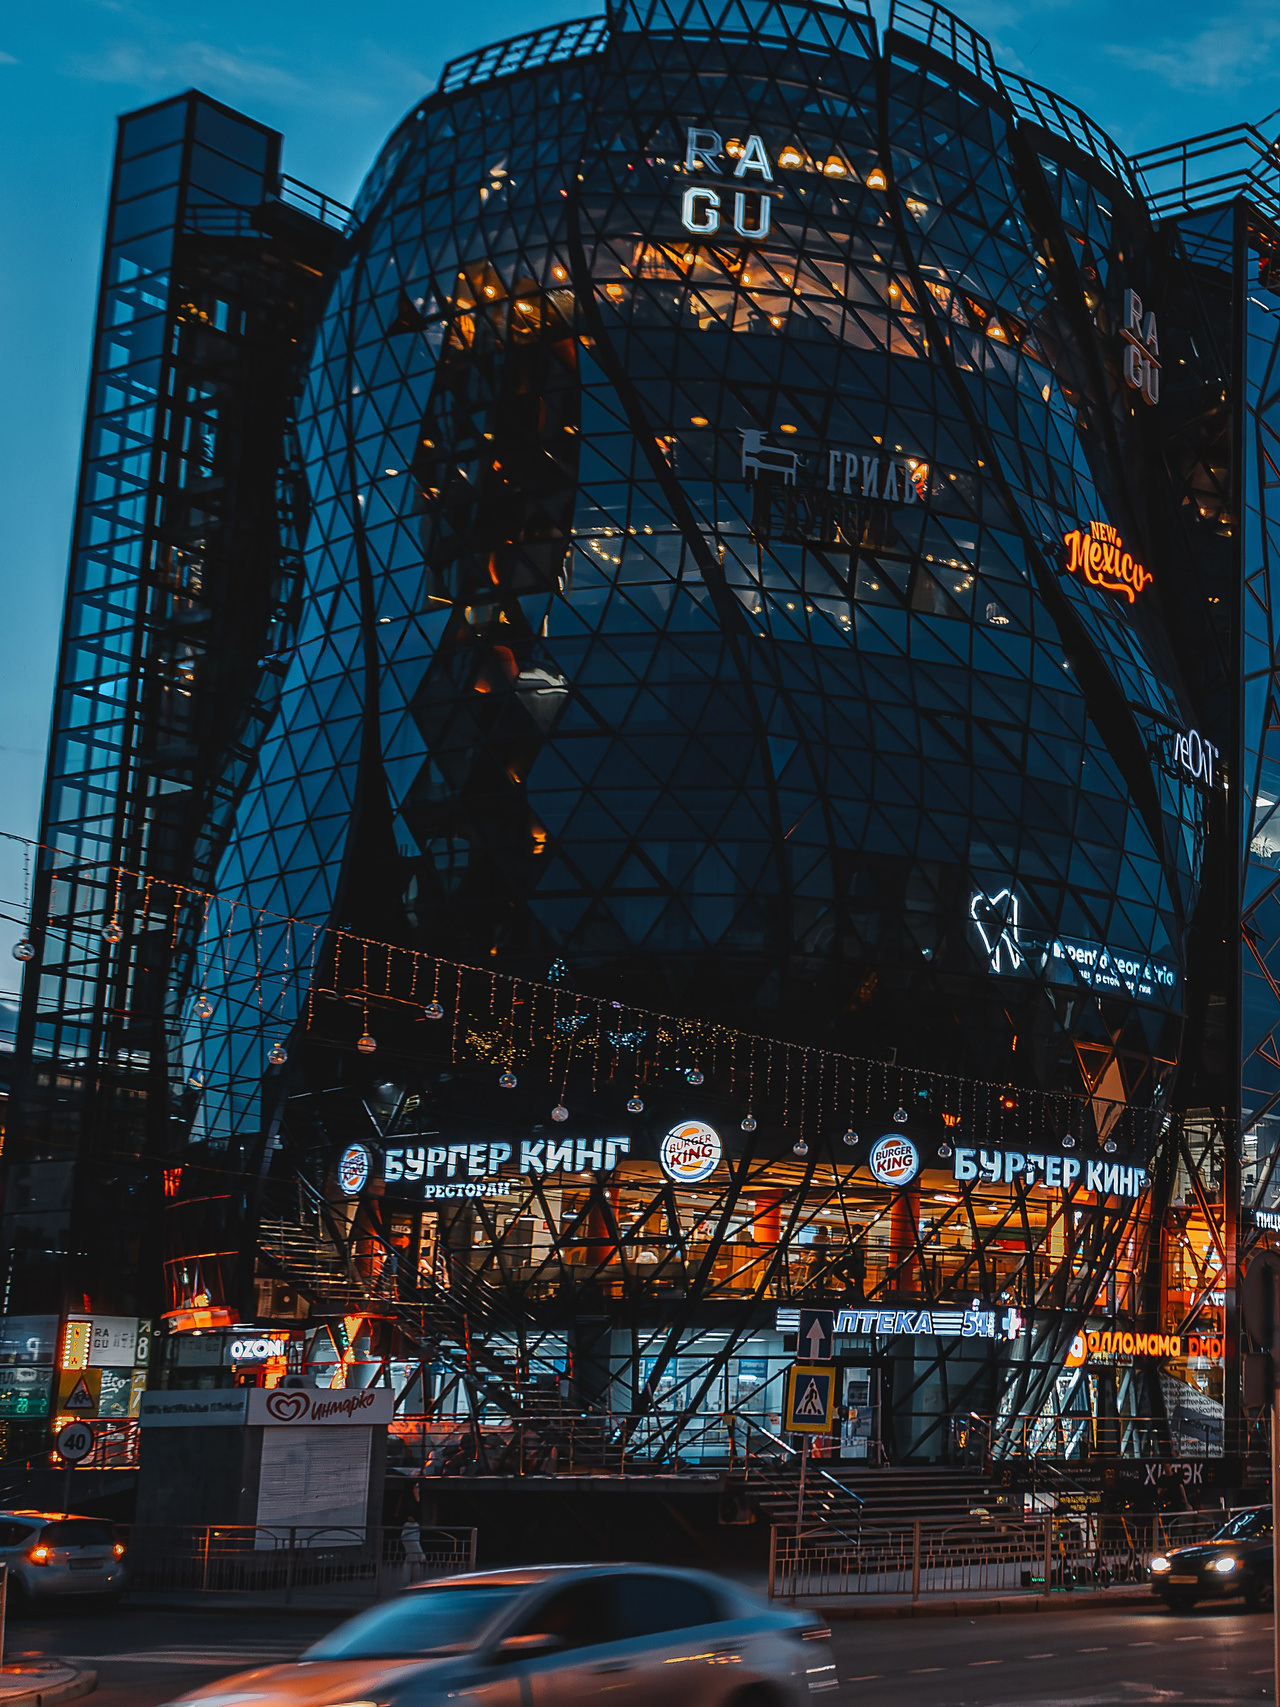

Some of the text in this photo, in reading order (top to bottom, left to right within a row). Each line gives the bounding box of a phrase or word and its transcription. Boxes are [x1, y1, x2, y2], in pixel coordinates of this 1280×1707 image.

[686, 127, 773, 182] RA
[682, 187, 771, 239] GU
[1124, 288, 1158, 351] RA
[1123, 343, 1159, 405] GU
[1090, 521, 1117, 543] NEW
[1064, 530, 1153, 603] Mexico
[669, 1132, 712, 1153] BURGER
[670, 1143, 713, 1169] KING
[875, 1145, 913, 1162] BURGER
[384, 1136, 630, 1183] БУРГЕР КИНГ
[876, 1154, 913, 1173] KING
[954, 1147, 1080, 1189] БУРГЕР
[424, 1182, 510, 1199] РЕСТОРАН
[832, 1309, 933, 1335] ПТЕКА
[961, 1310, 990, 1338] 54
[231, 1339, 284, 1359] OZON
[63, 1433, 86, 1450] 40
